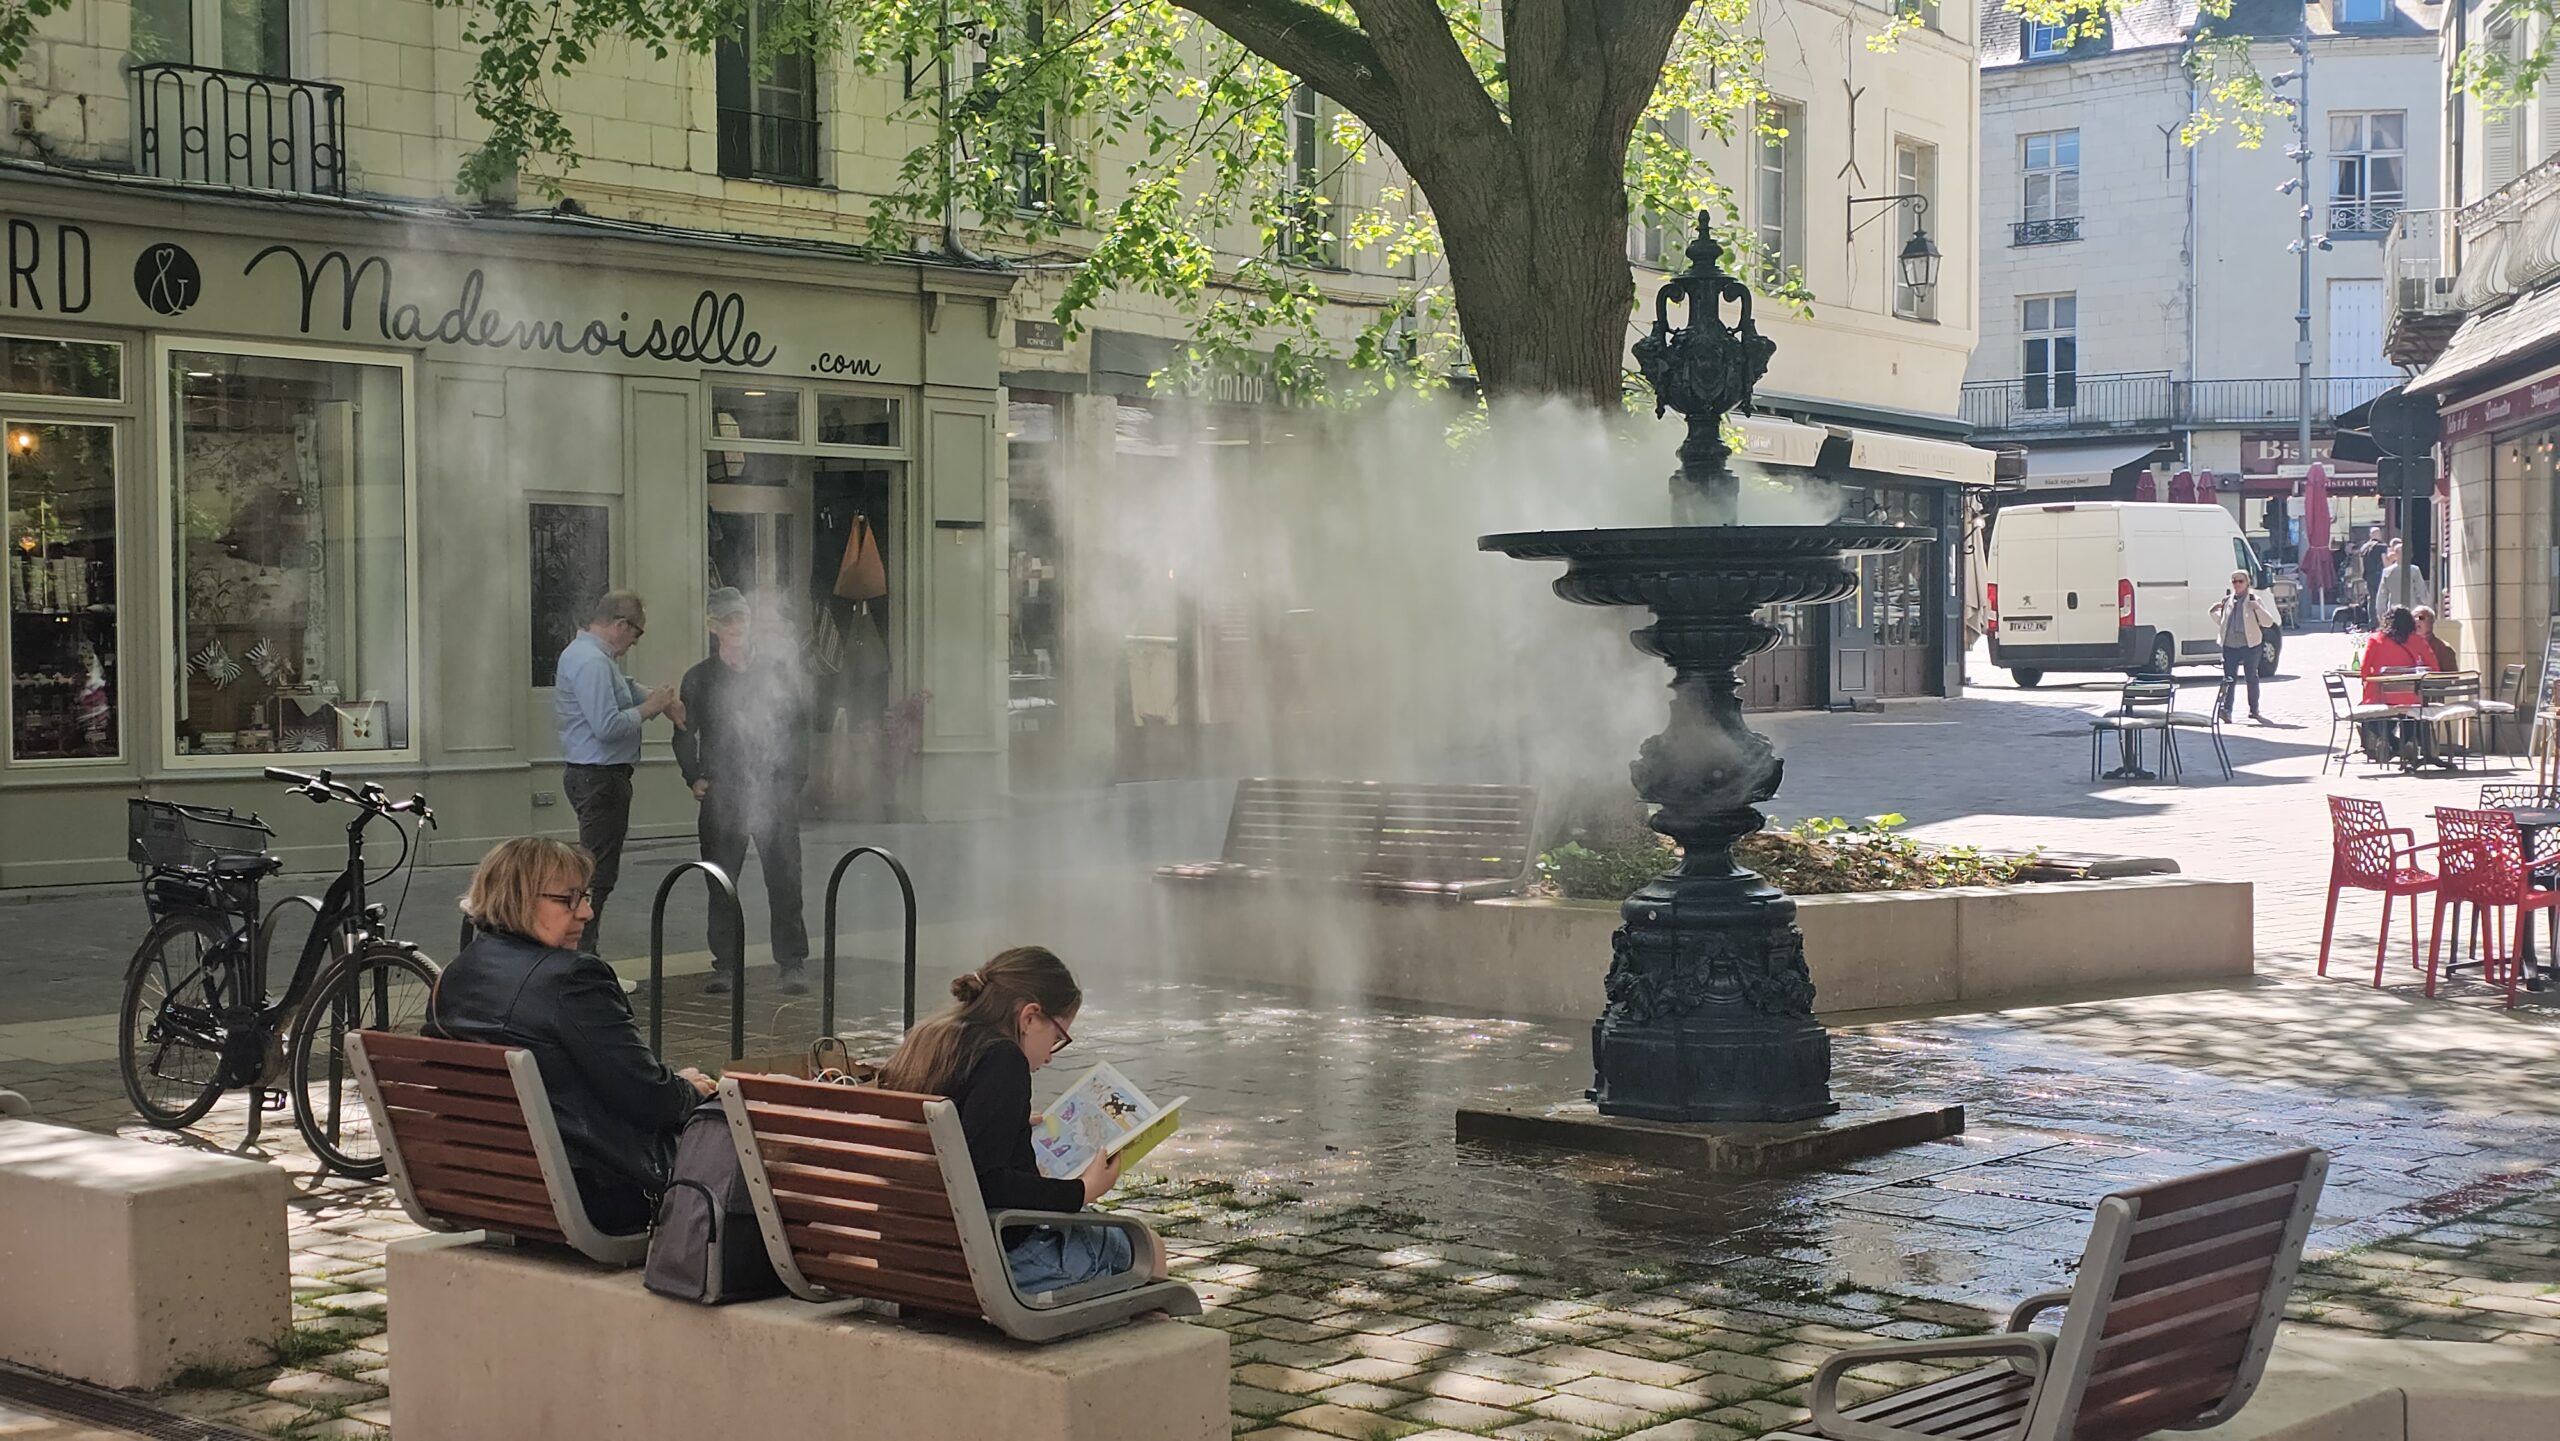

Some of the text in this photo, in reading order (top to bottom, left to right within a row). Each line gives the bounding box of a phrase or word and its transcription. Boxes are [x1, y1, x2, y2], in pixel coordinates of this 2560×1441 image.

[0, 219, 91, 313] RD
[244, 246, 777, 368] Mademoiselle
[2258, 440, 2332, 459] Bisro
